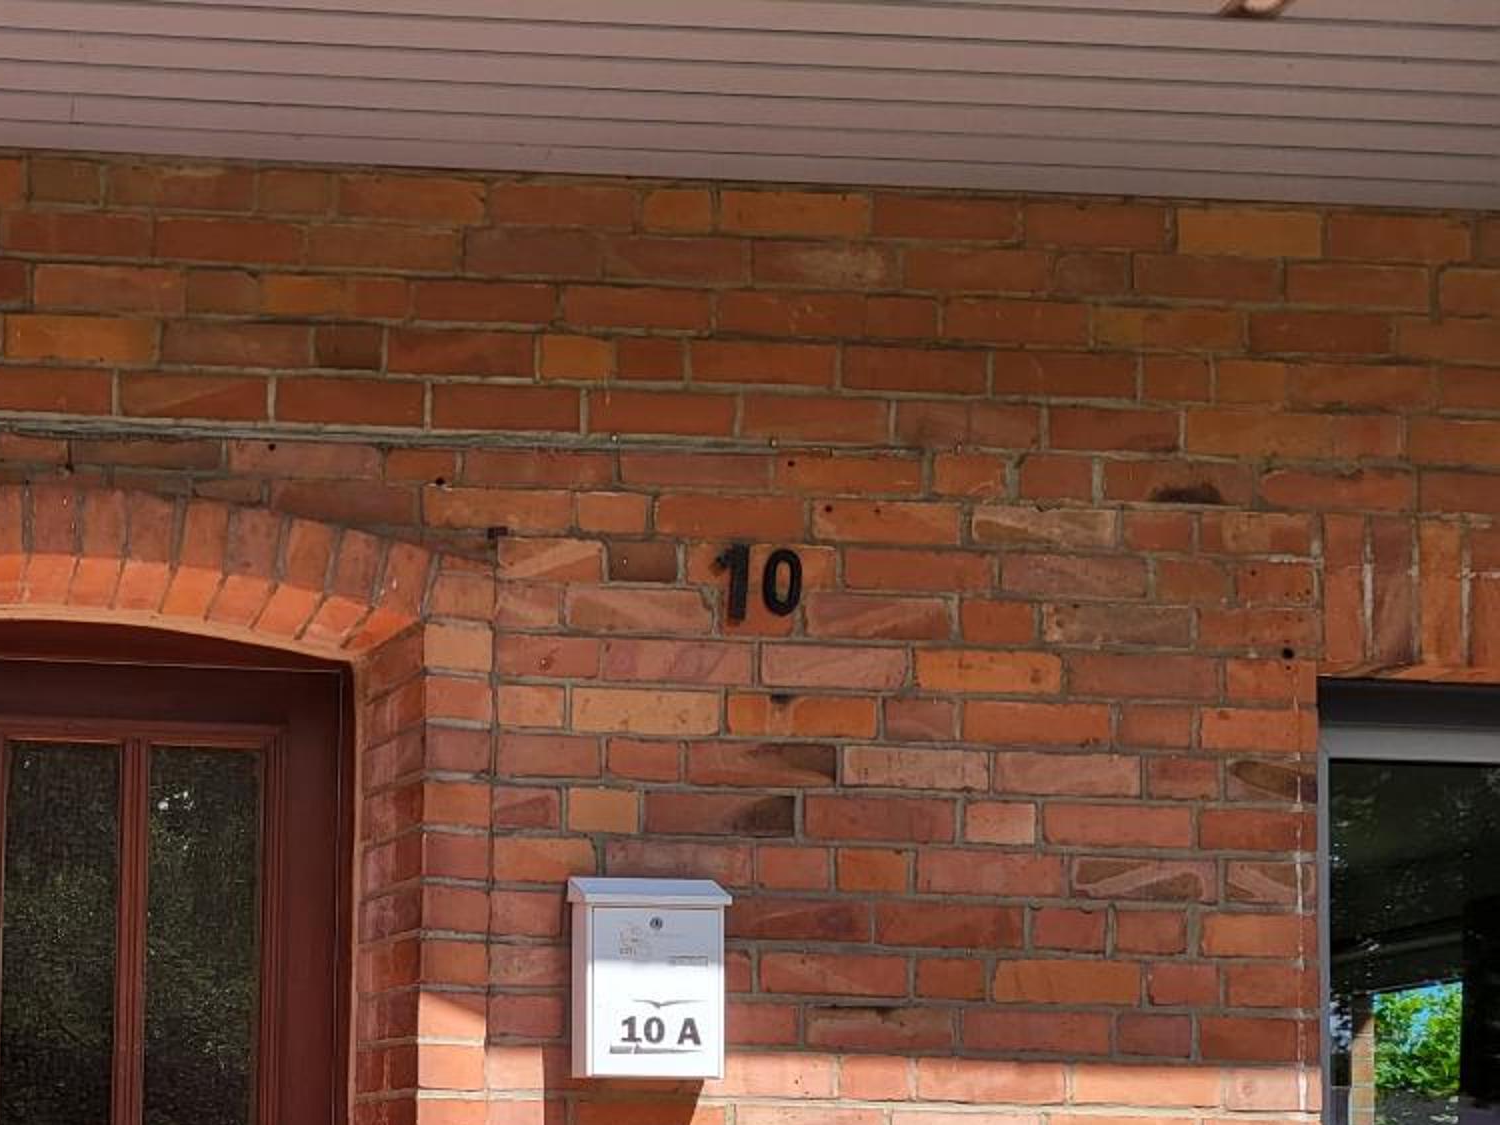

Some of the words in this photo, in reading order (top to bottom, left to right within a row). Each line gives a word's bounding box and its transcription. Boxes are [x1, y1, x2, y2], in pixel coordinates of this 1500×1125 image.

[715, 542, 803, 622] 10
[620, 1016, 666, 1045] 10
[676, 1017, 702, 1046] A
